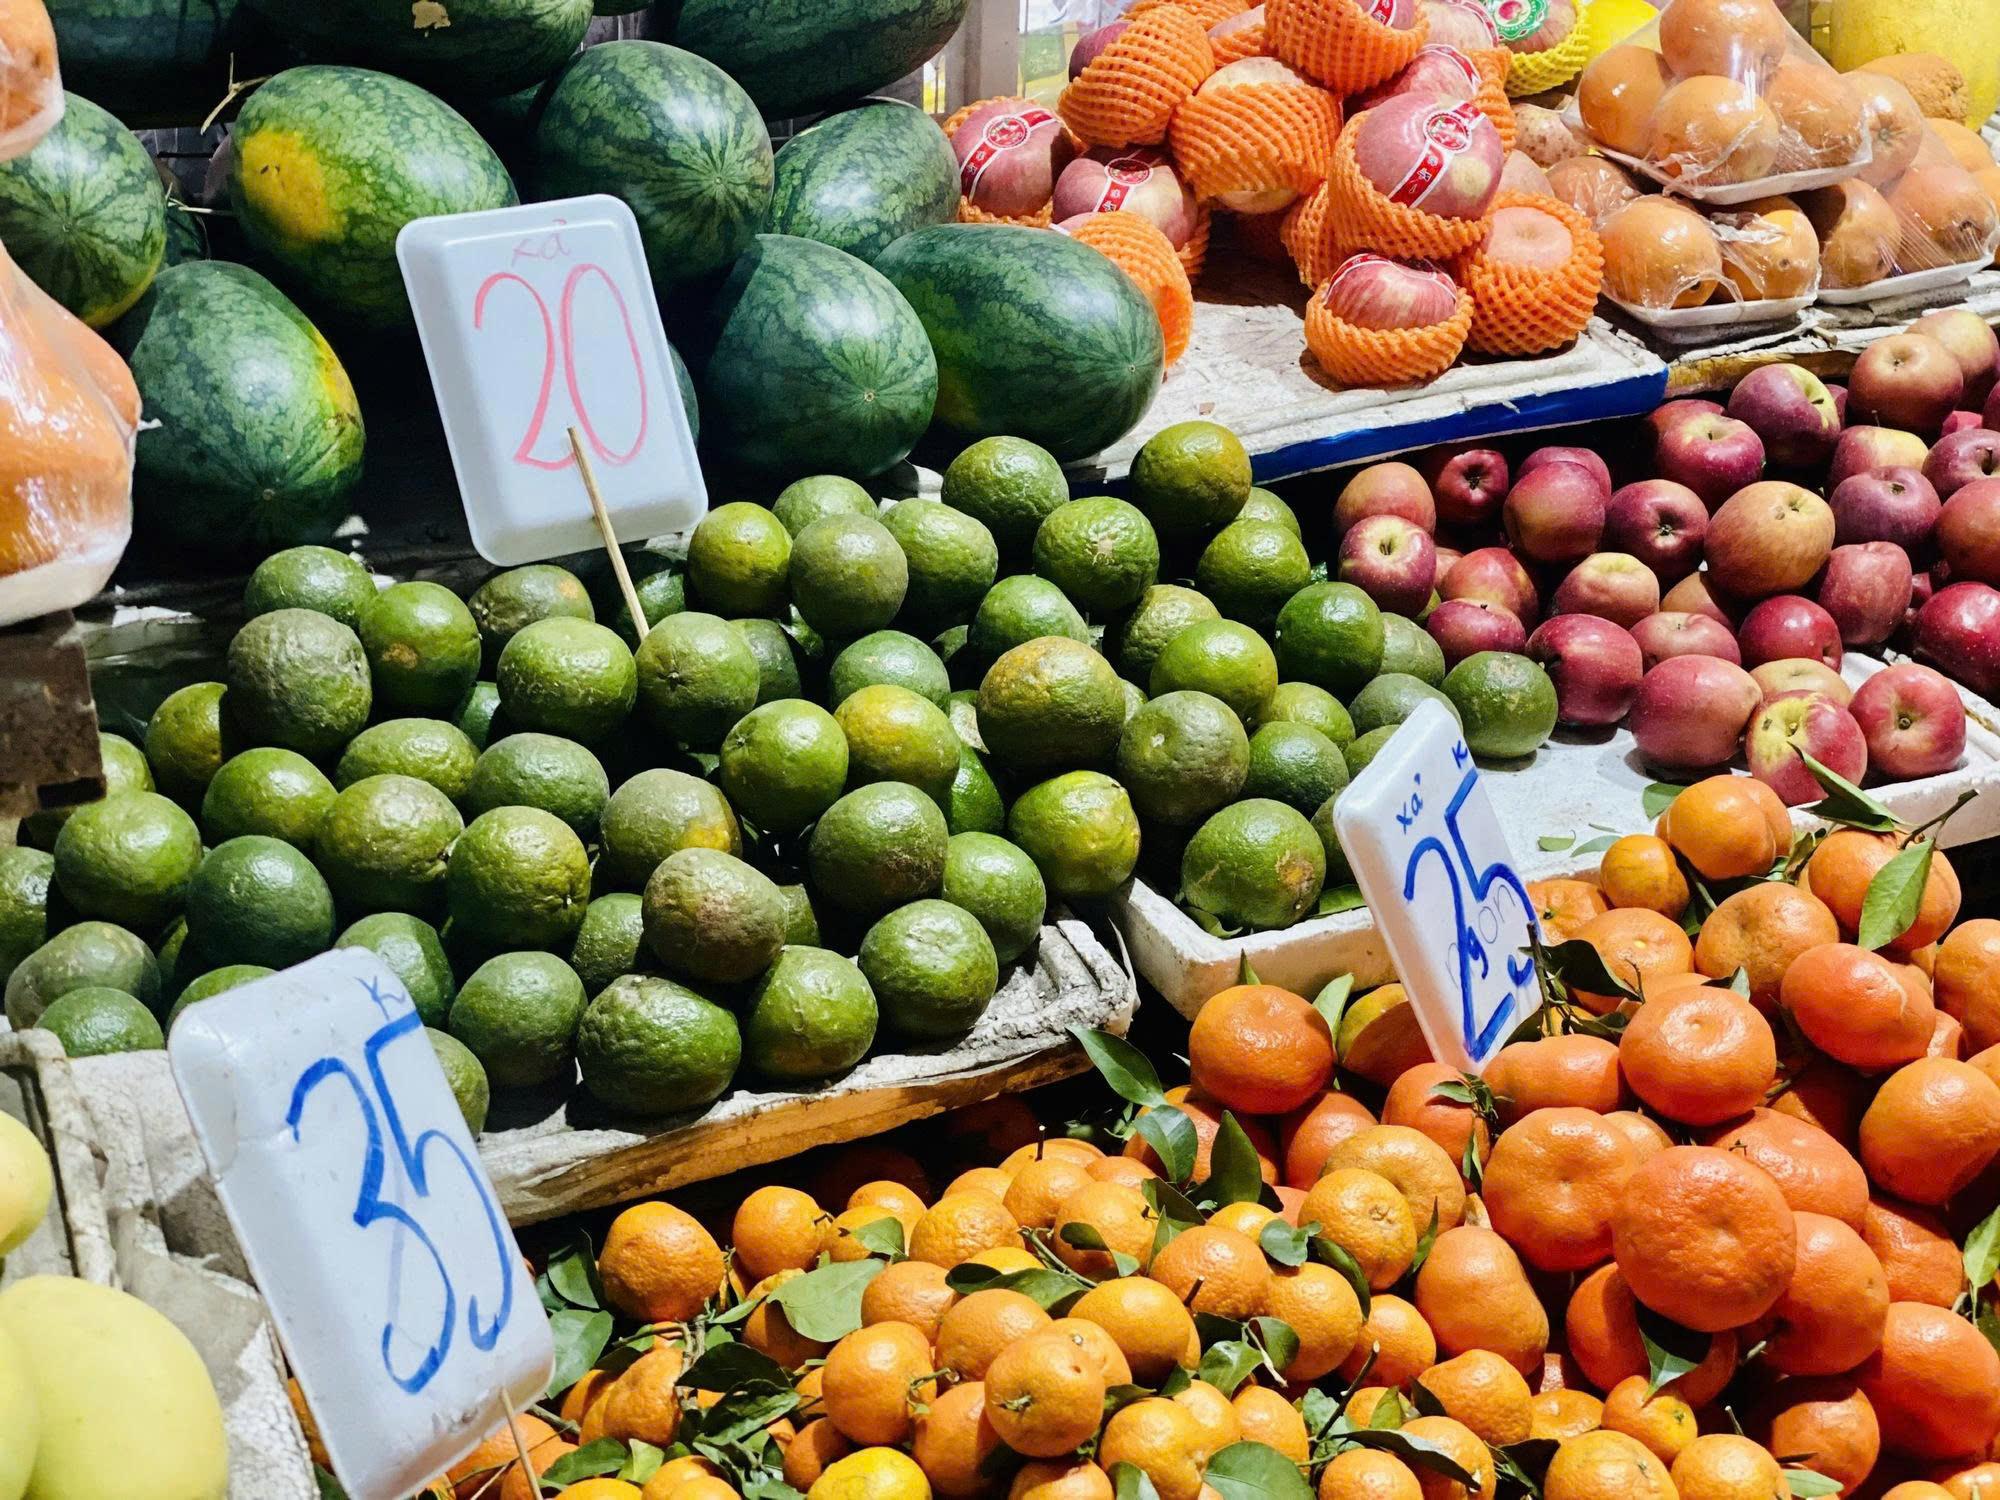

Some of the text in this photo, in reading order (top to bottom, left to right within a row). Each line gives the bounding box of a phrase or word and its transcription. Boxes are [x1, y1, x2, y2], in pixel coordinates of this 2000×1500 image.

[473, 263, 647, 471] 20
[1403, 766, 1539, 1063] 25
[285, 1010, 513, 1395] 35
